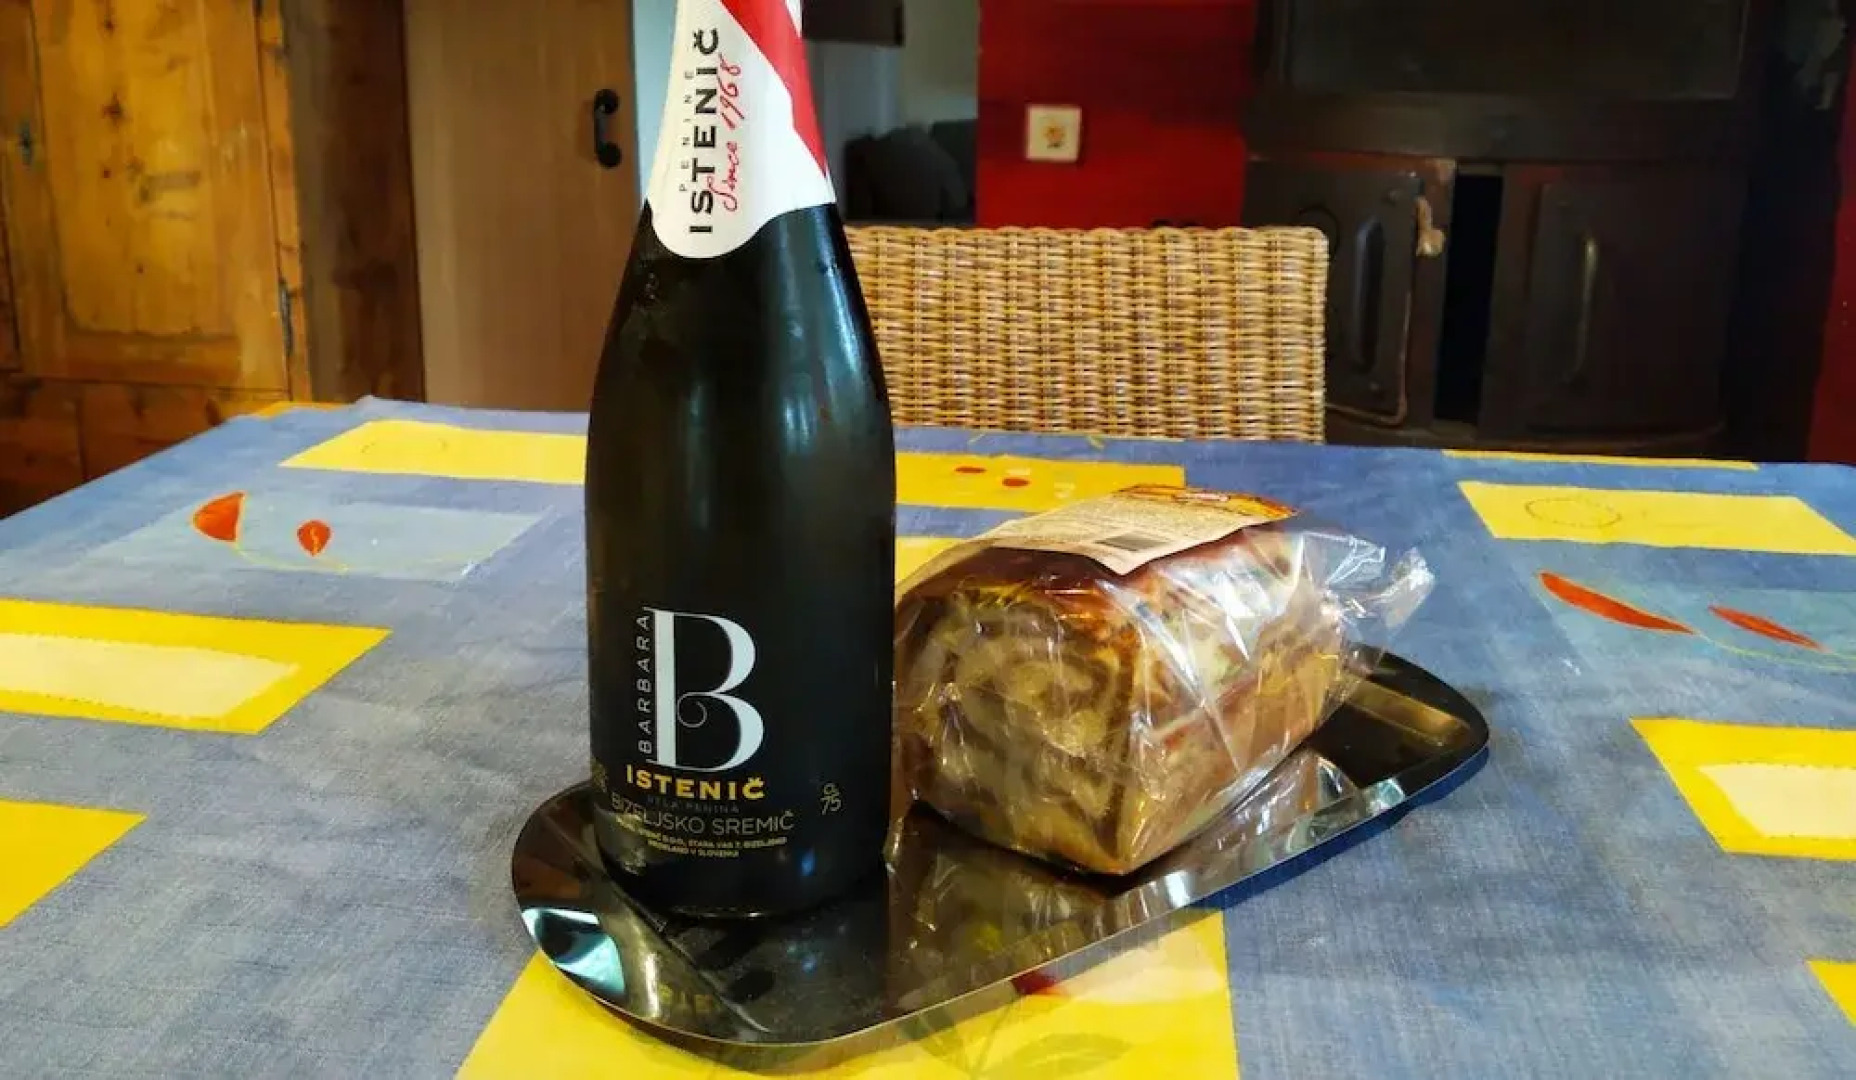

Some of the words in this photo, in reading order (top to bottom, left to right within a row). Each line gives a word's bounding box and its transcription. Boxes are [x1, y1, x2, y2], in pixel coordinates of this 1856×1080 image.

[689, 28, 719, 234] ISTENIČ
[716, 51, 746, 131] 1968
[679, 71, 695, 193] PENINE
[635, 614, 653, 755] BARBARA
[611, 791, 706, 834] BIZELJSKO
[712, 809, 795, 836] SREMIČ
[626, 763, 766, 800] ISTENIČ
[820, 797, 842, 816] 75
